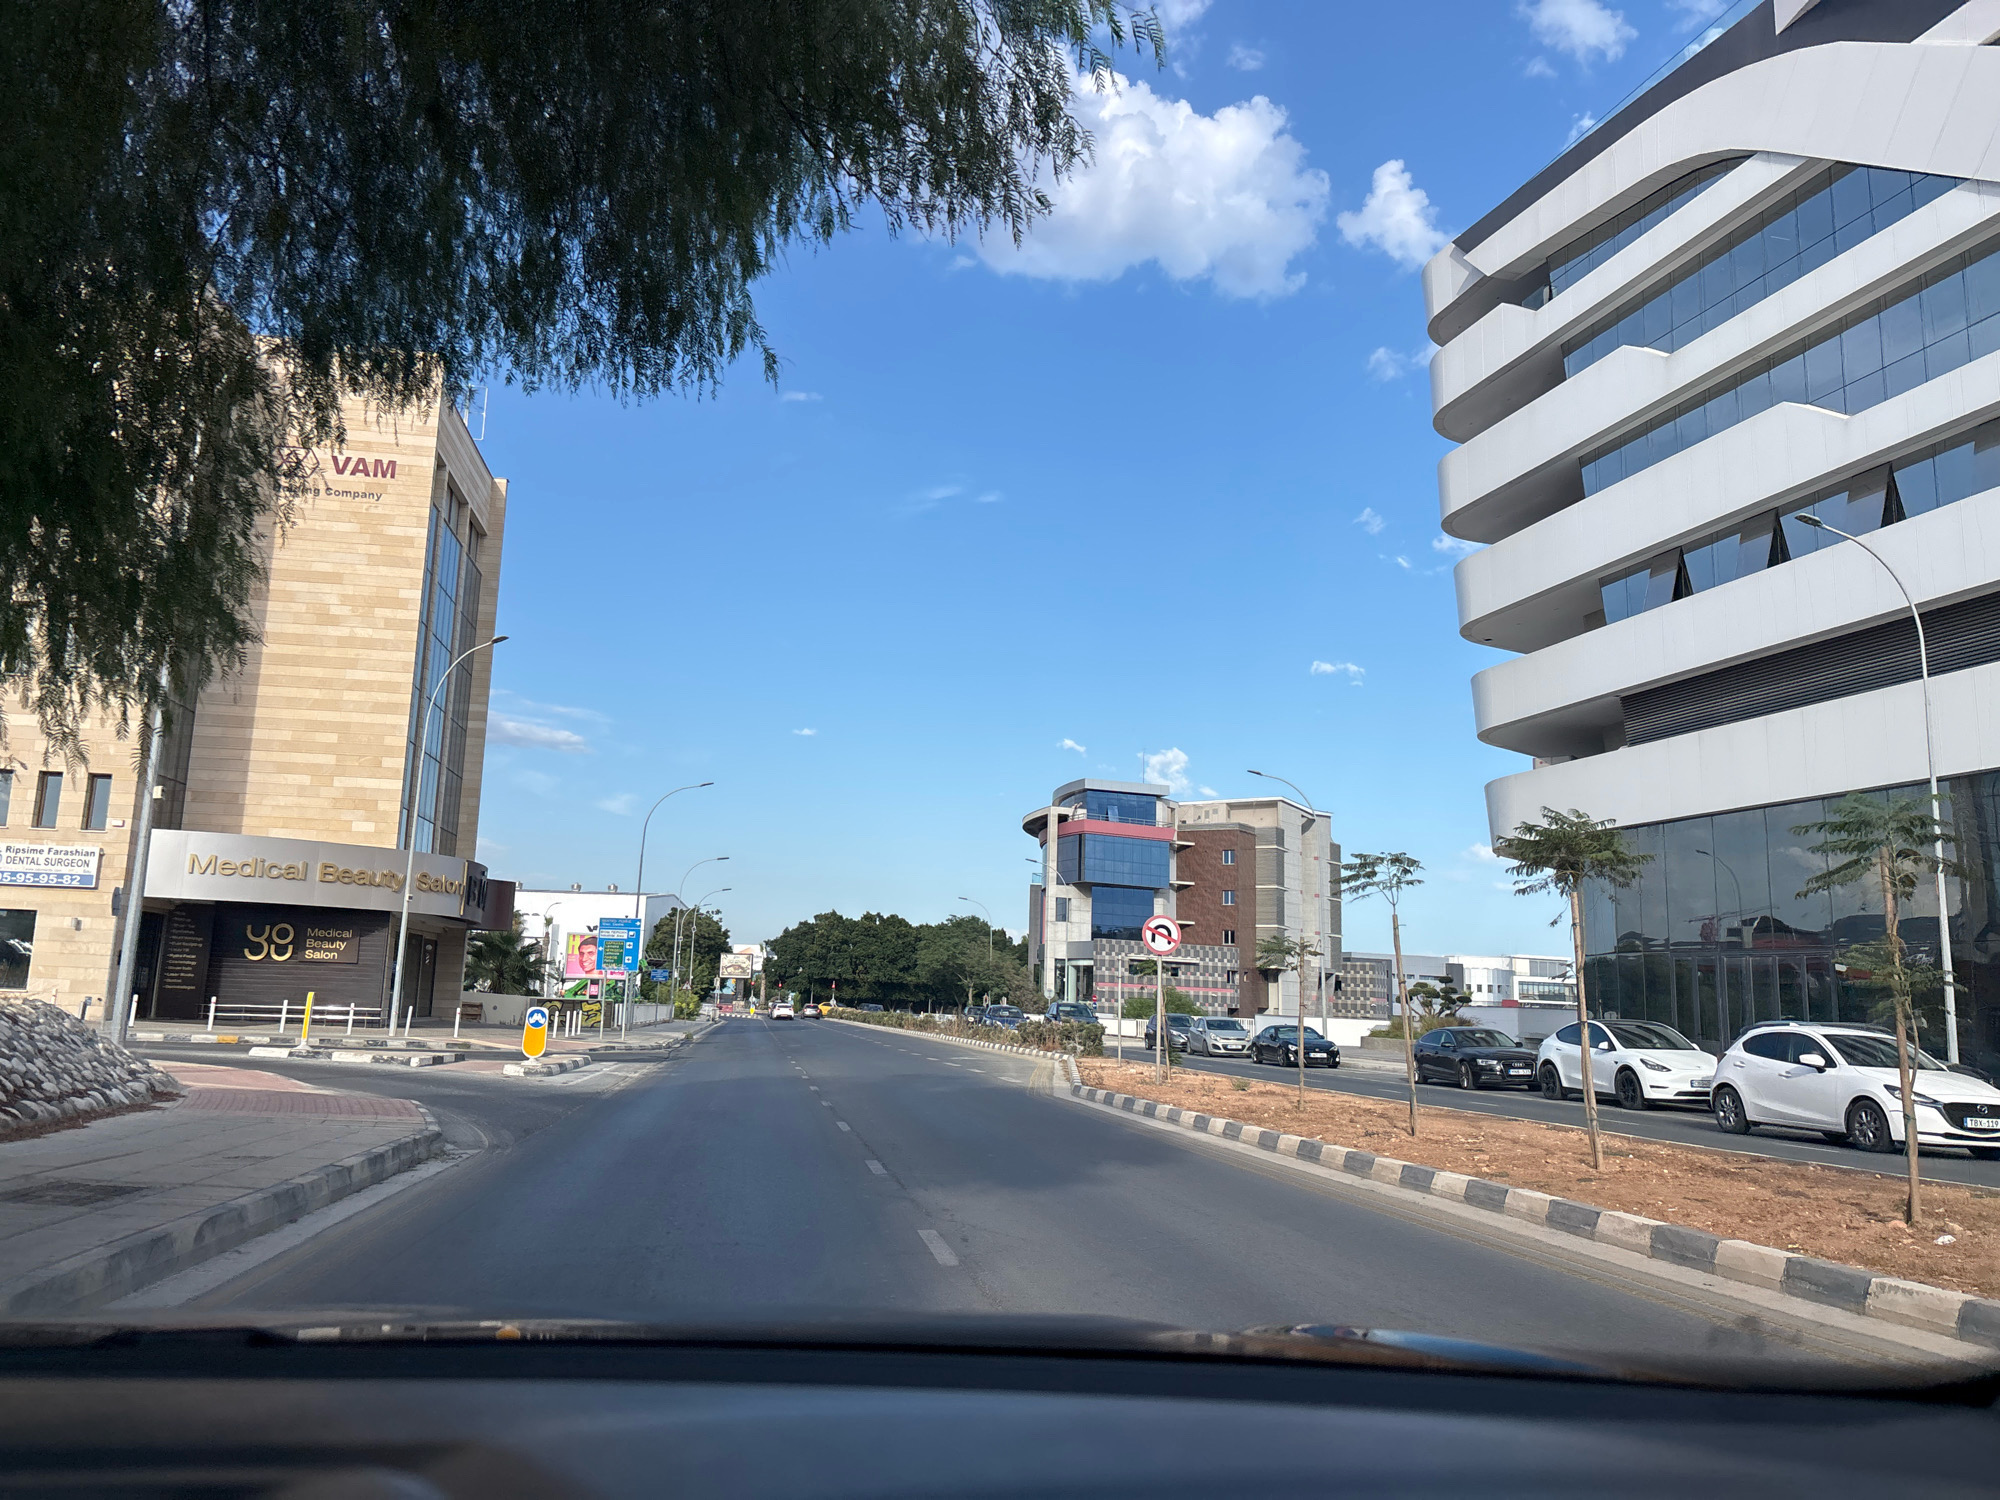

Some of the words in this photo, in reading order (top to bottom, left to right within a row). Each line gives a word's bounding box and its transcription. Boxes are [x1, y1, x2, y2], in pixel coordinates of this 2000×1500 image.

[331, 455, 397, 479] VAM
[325, 487, 383, 501] Company
[5, 845, 45, 855] Ripsime
[47, 847, 96, 857] Farashian
[5, 855, 41, 866] DENTAL
[43, 857, 91, 868] SURGEON
[188, 853, 308, 881] Medical
[318, 862, 406, 892] Beauty
[416, 871, 465, 896] Salon
[306, 928, 353, 938] Medical
[305, 938, 347, 950] Beauty
[304, 949, 338, 960] Salon
